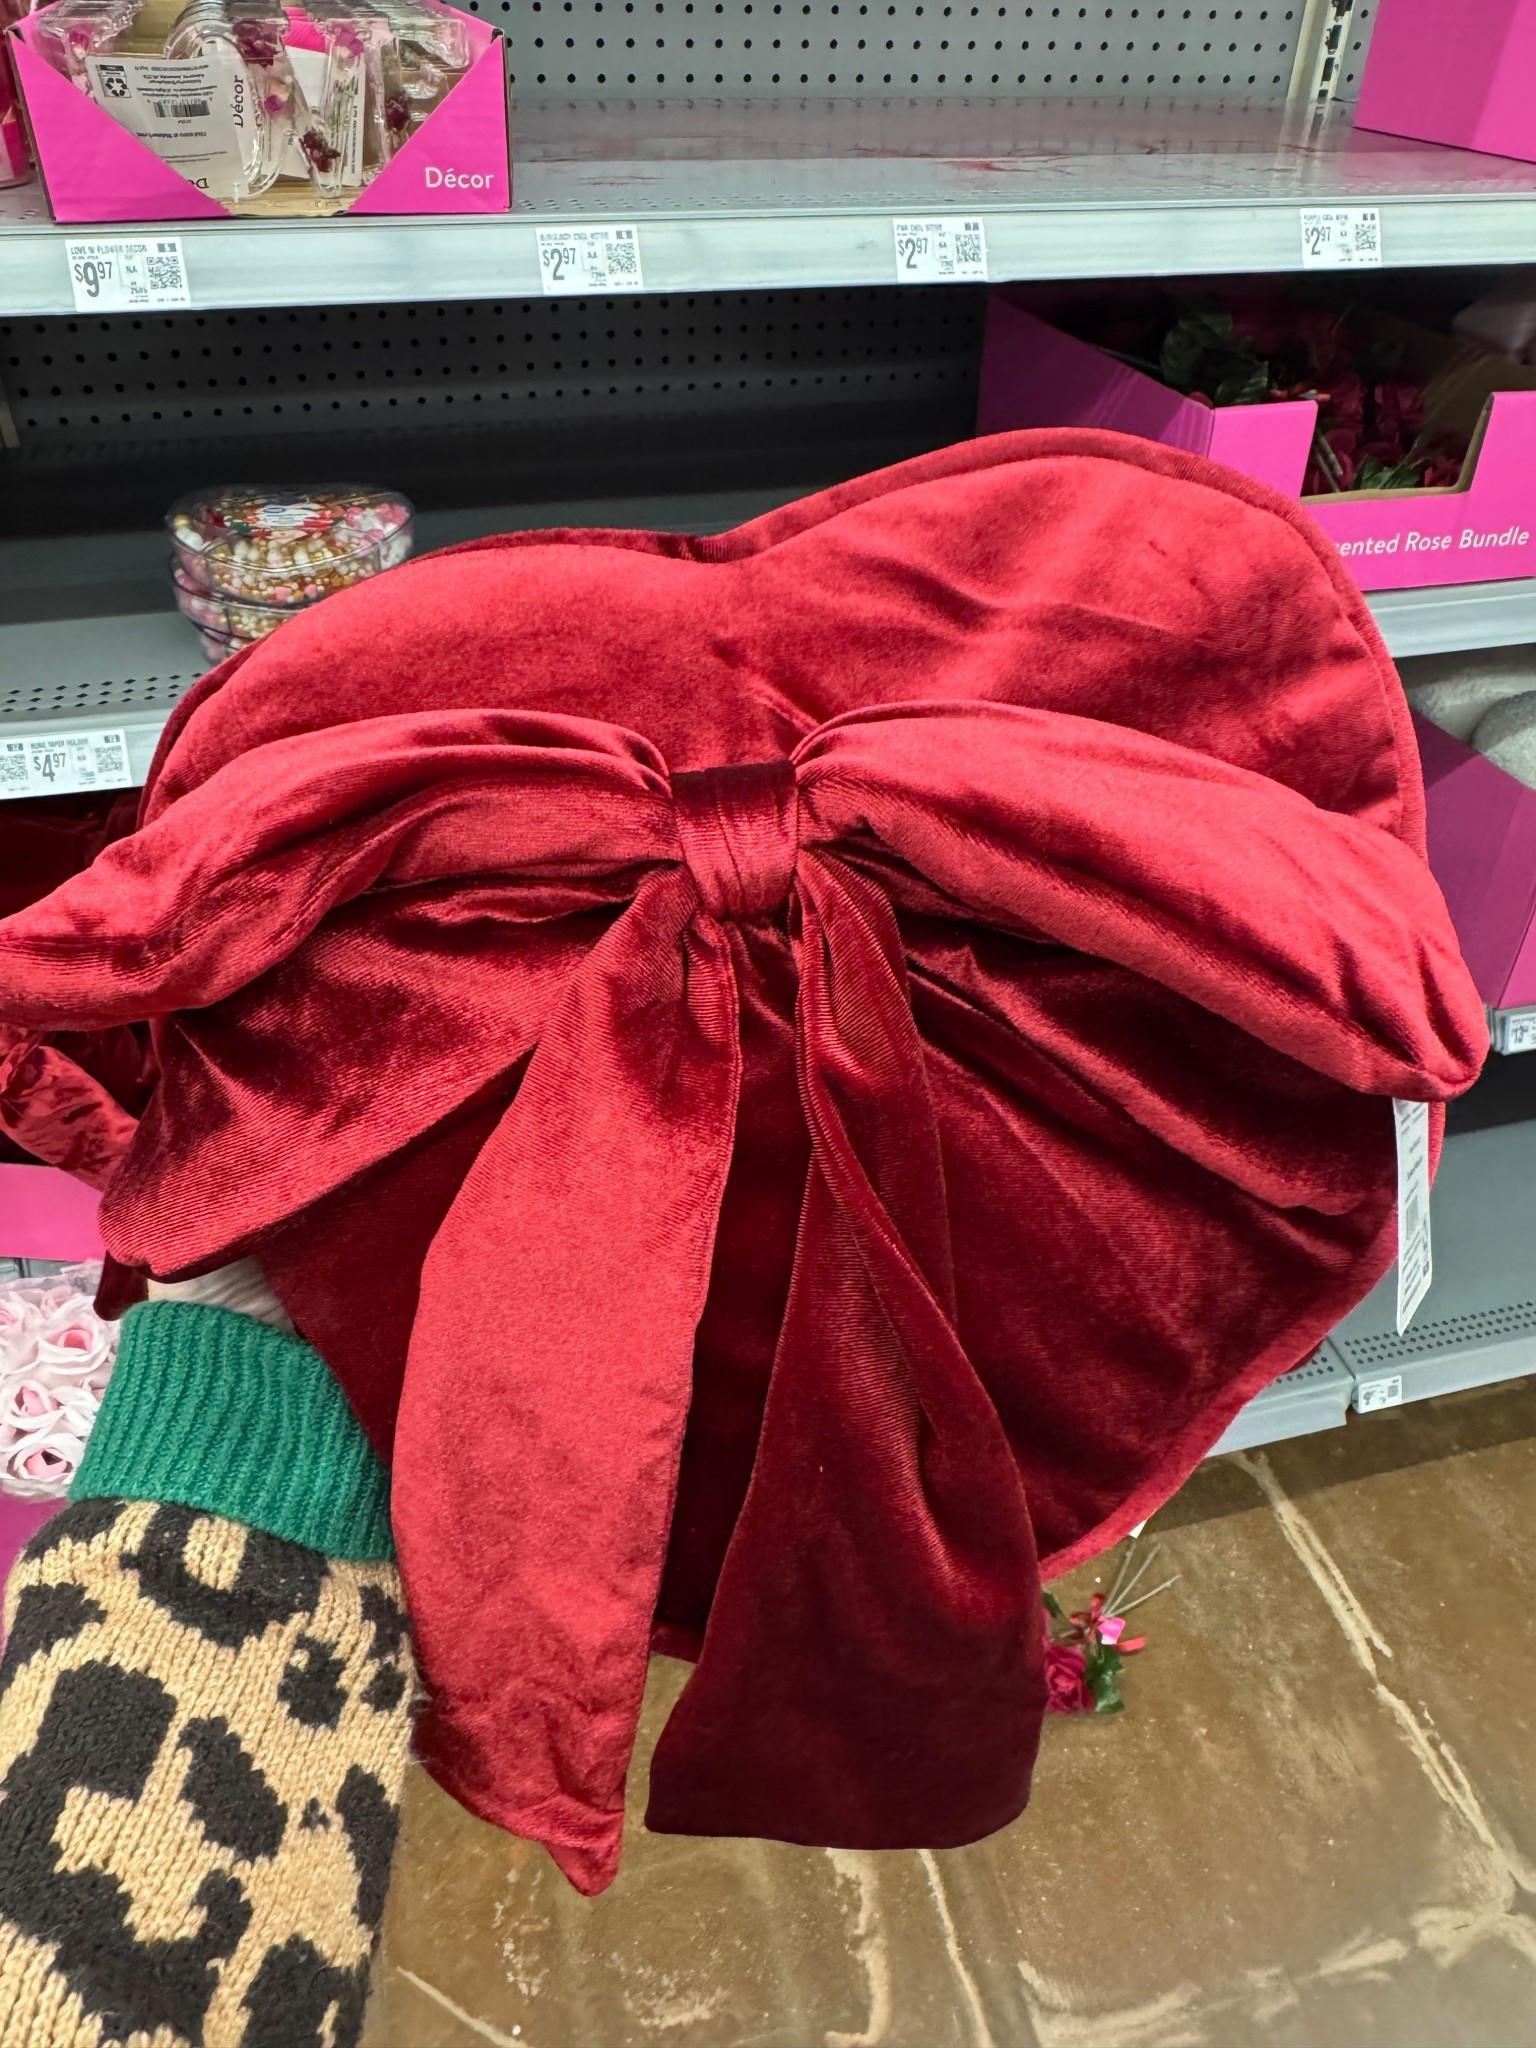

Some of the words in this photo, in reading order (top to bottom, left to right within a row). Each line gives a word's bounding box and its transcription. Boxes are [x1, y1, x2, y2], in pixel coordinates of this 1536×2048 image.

[425, 166, 495, 189] Décor
[1335, 533, 1400, 557] ented
[1405, 531, 1453, 552] Rose
[1459, 525, 1531, 549] Bundle
